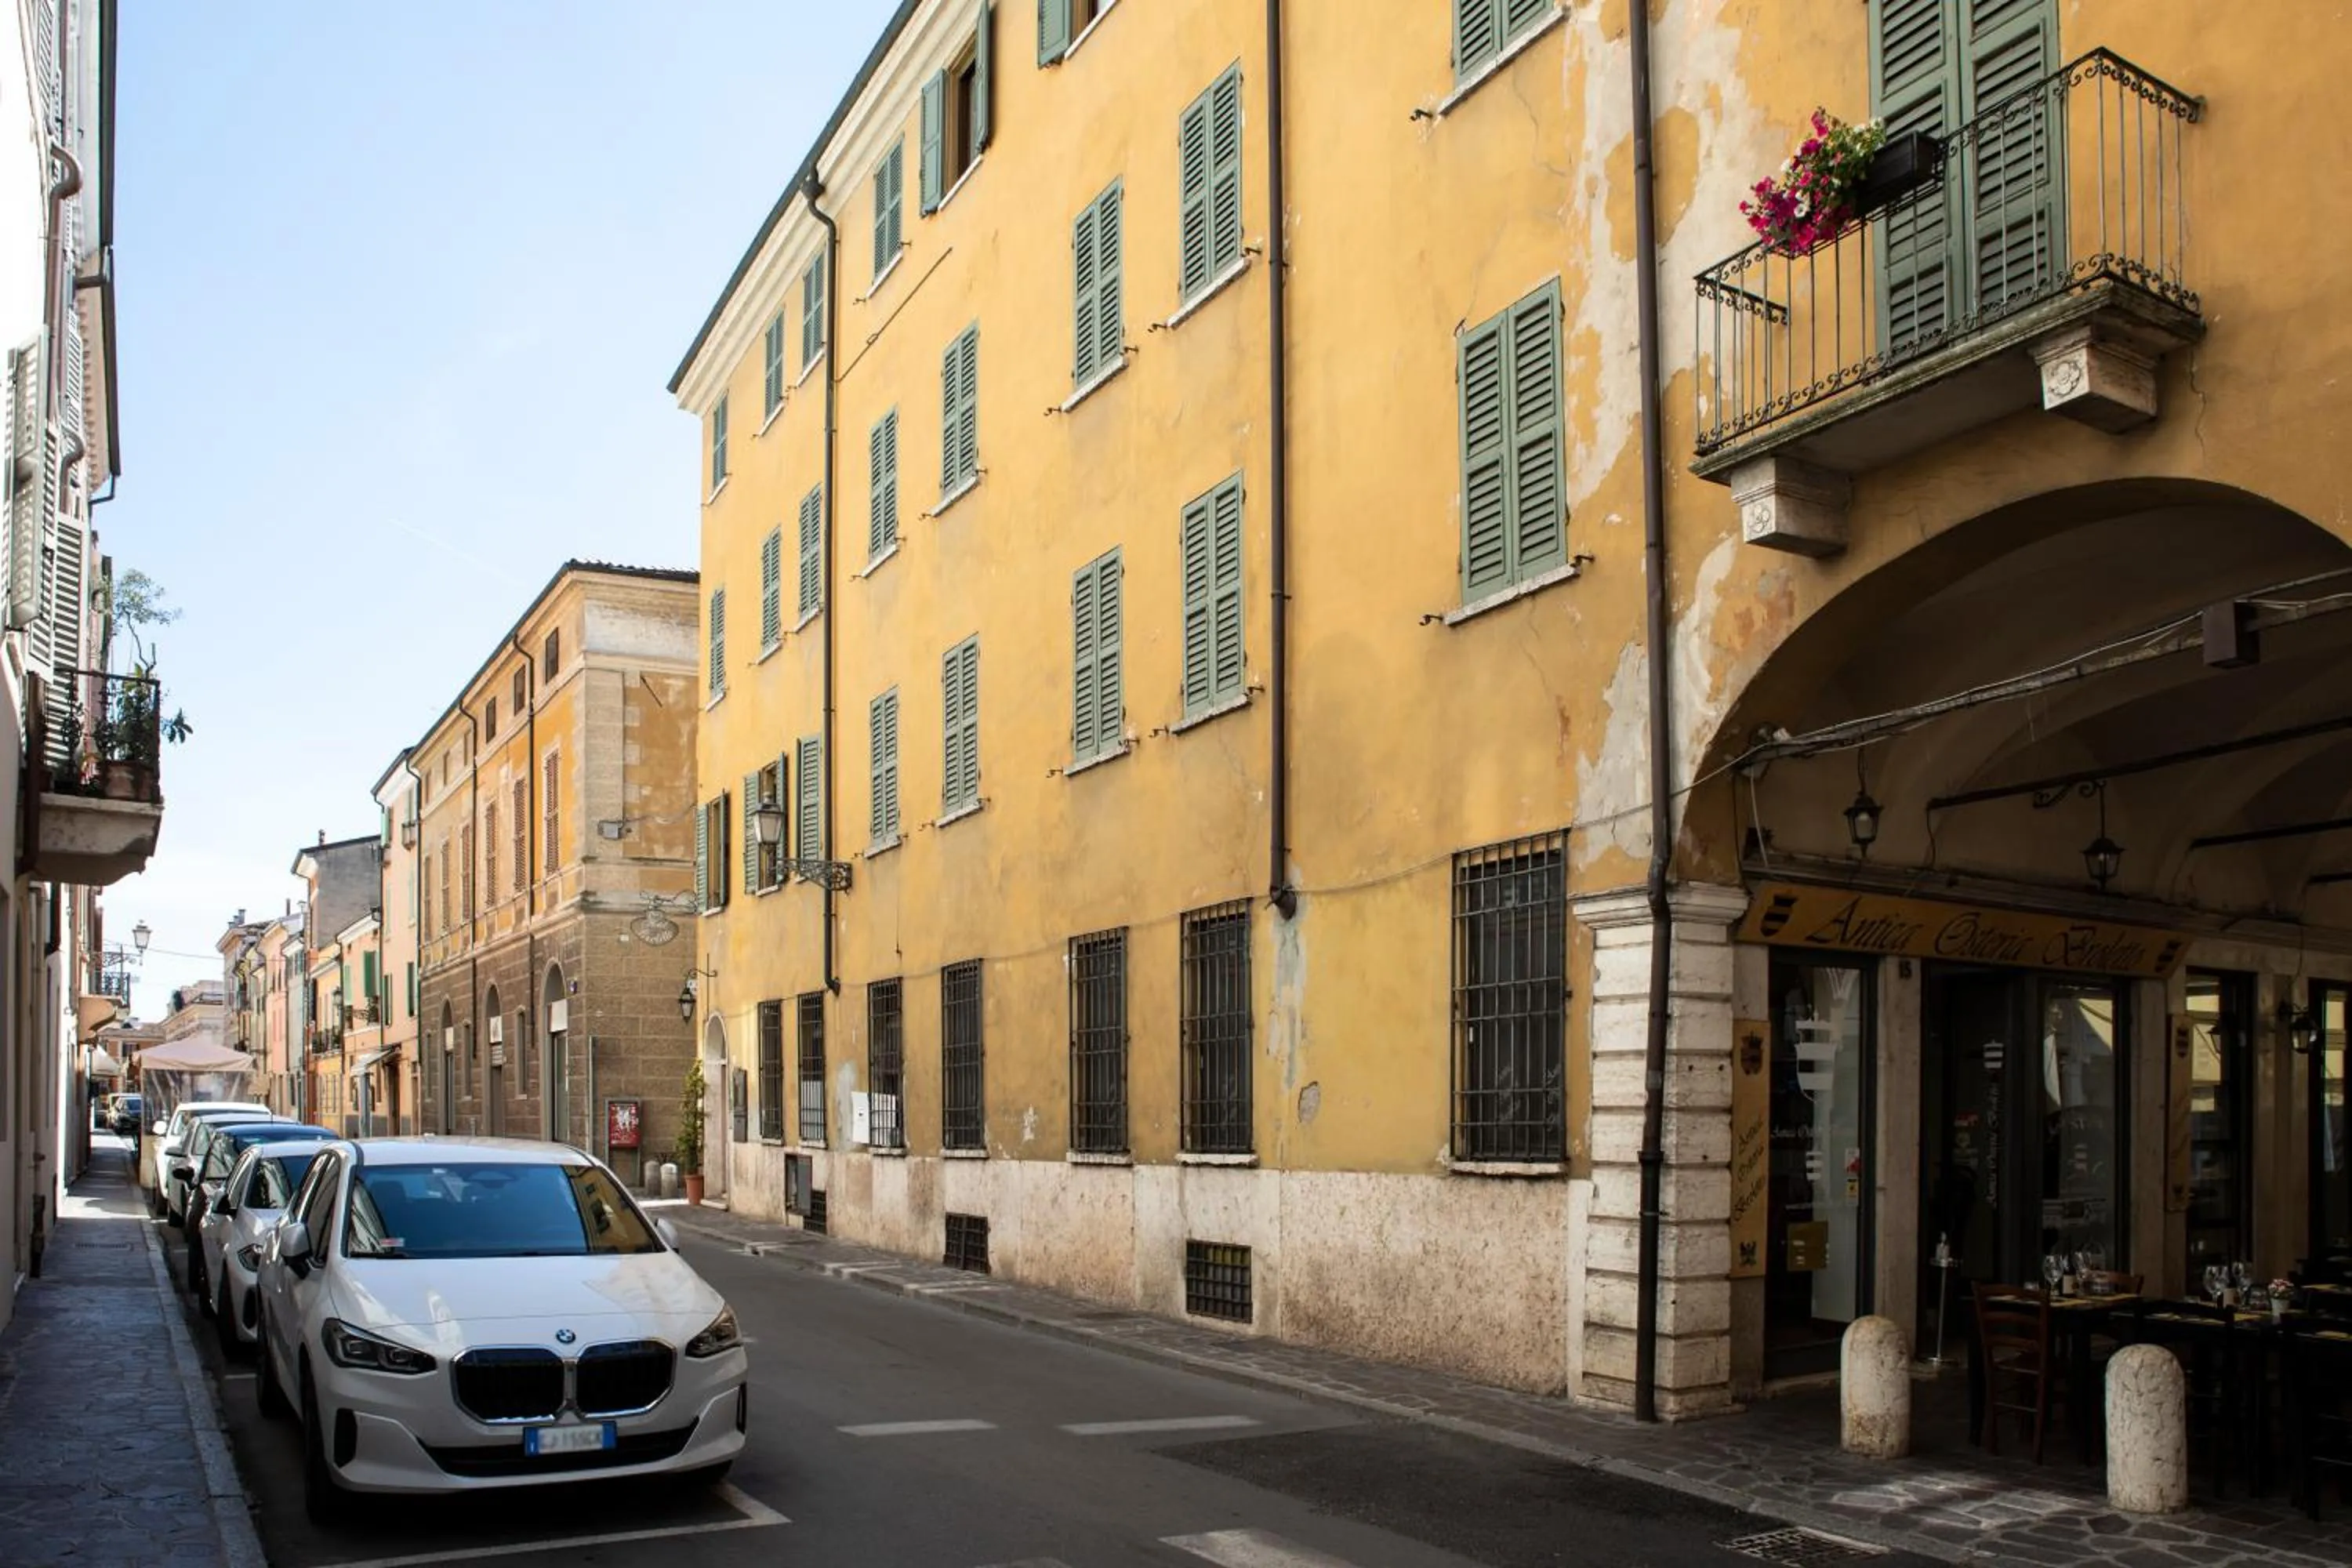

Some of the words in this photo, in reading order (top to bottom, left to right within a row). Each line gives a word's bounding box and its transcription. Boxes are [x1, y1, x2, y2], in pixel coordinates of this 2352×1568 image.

[1804, 895, 1924, 952] Antica
[1934, 912, 2034, 960] Osteria
[2042, 925, 2146, 970] Broletto
[1900, 961, 1911, 978] 15
